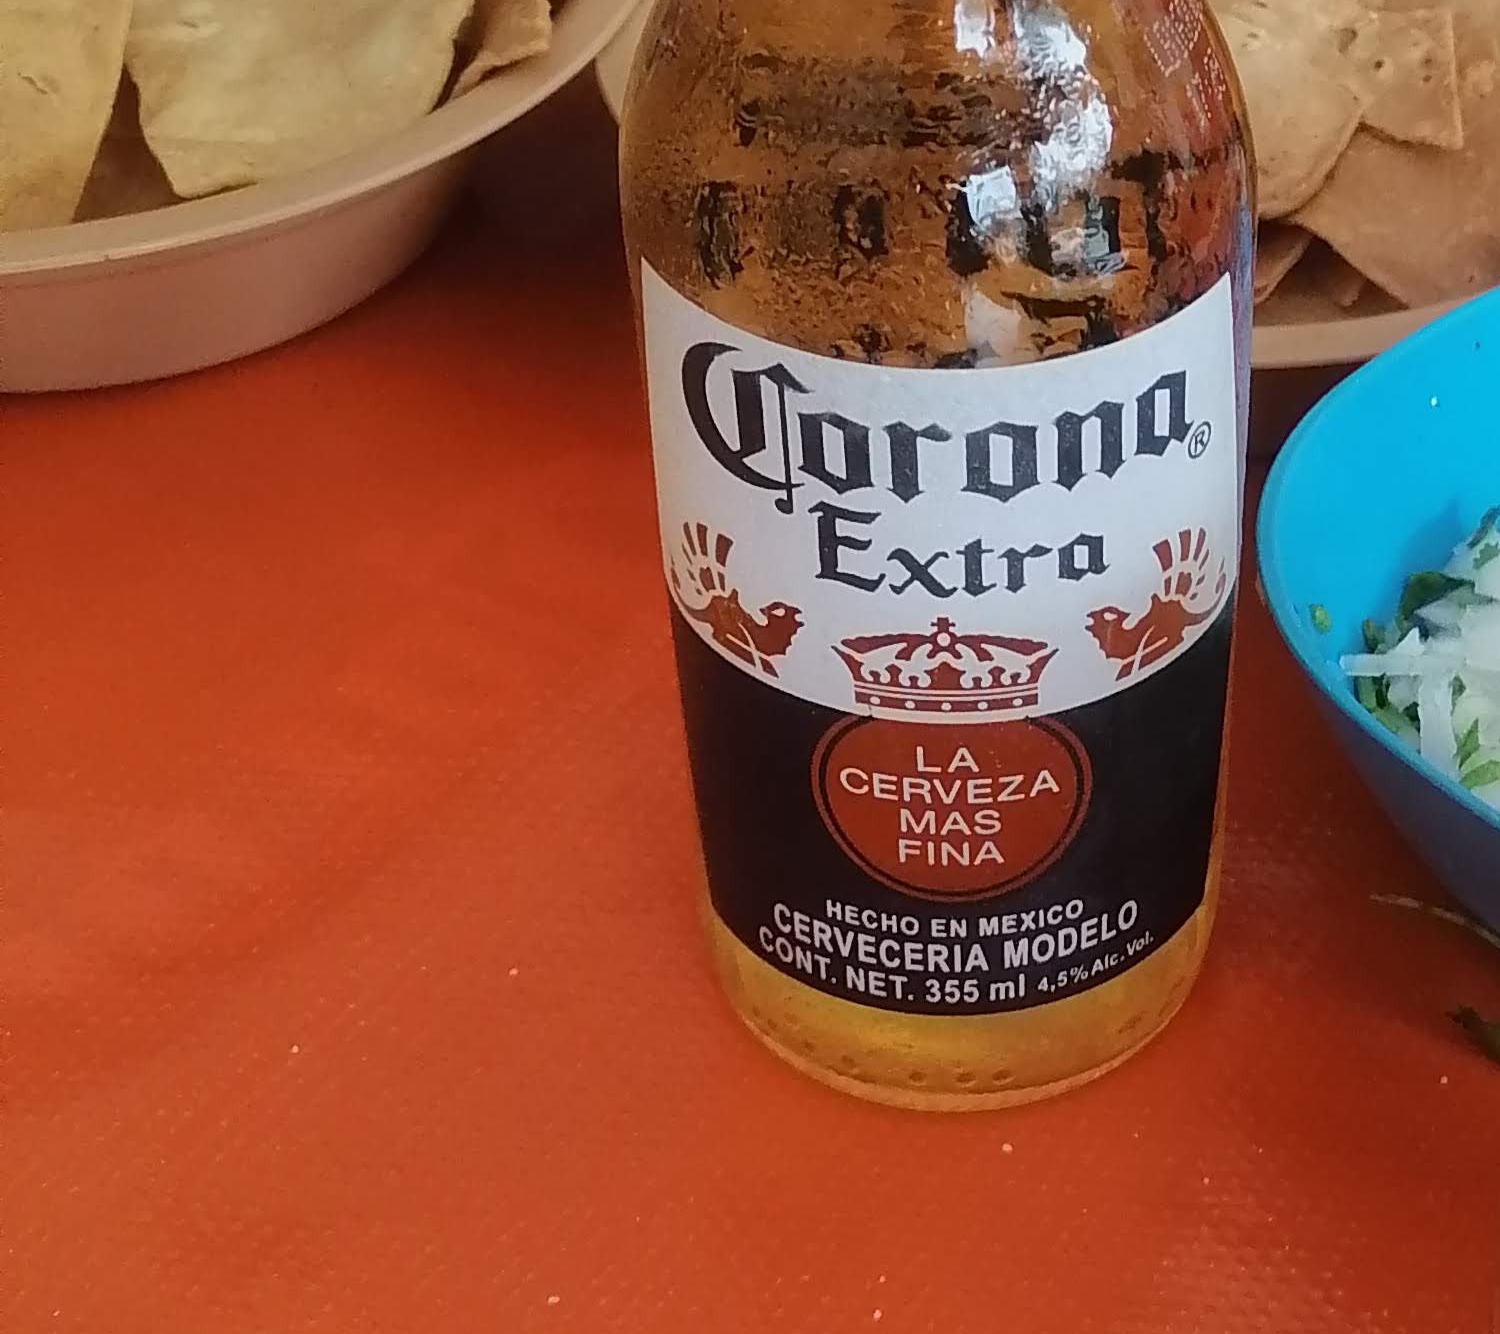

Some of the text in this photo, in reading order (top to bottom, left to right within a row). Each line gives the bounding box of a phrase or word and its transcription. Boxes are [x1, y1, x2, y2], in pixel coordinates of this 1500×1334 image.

[681, 341, 1194, 514] Corona
[808, 501, 1111, 598] Extra
[916, 746, 980, 773] LA
[839, 767, 1060, 804] CERVEZA
[900, 808, 1002, 835] MAS
[898, 839, 1005, 866] FINA
[773, 900, 1138, 973] CERVECERIA MODELO
[826, 899, 1083, 938] HECHO EN MEXICO
[759, 926, 836, 984] CONT.
[846, 965, 914, 1001] NET.
[925, 979, 979, 1003] 355
[989, 973, 1025, 1001] ml
